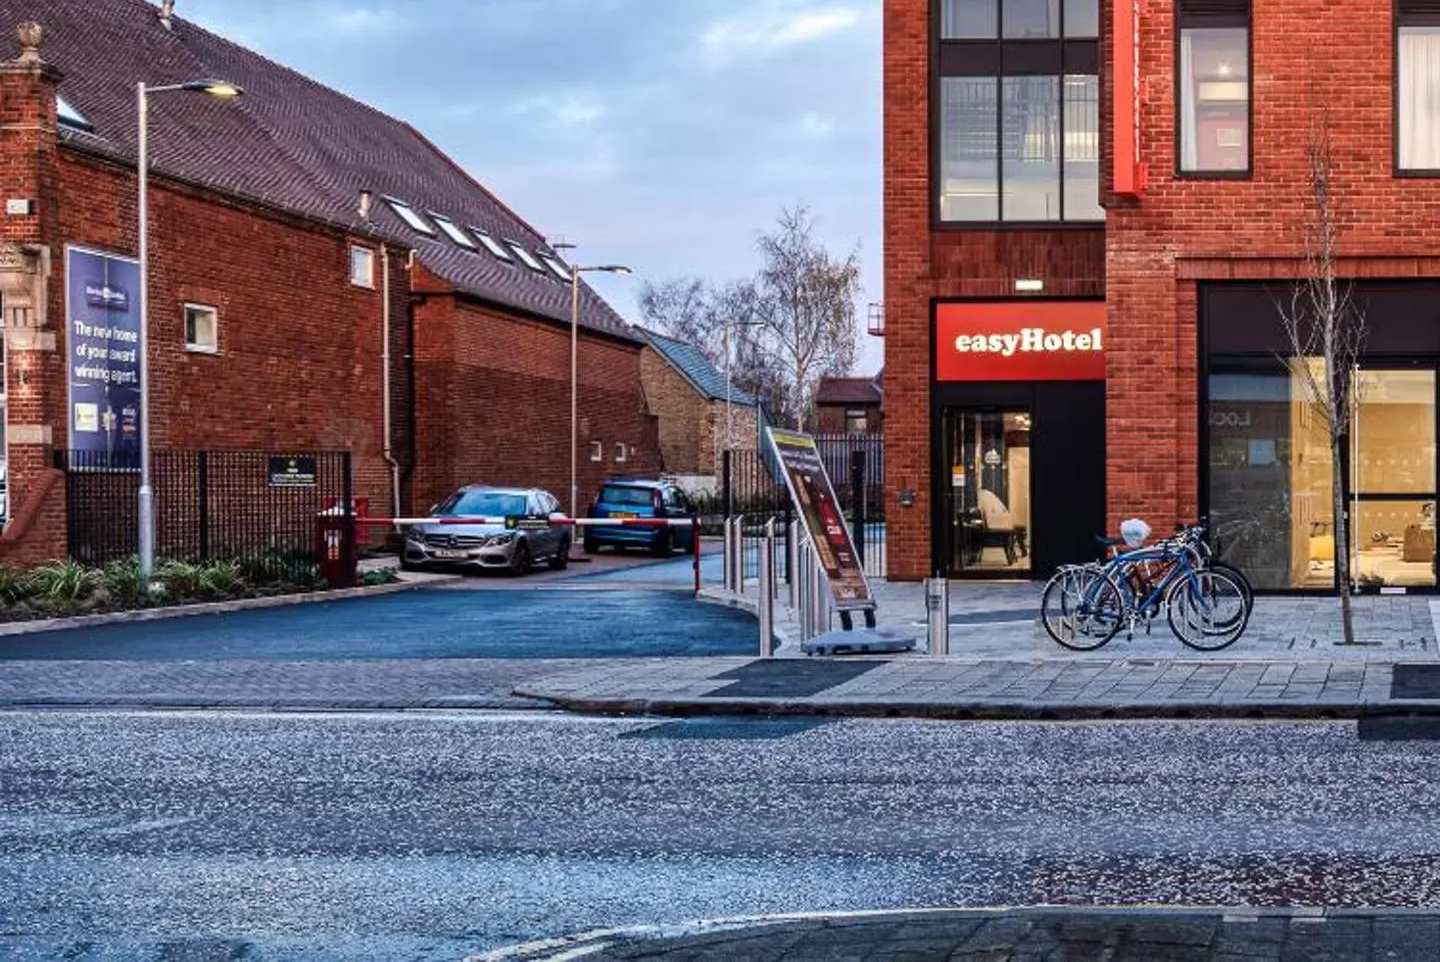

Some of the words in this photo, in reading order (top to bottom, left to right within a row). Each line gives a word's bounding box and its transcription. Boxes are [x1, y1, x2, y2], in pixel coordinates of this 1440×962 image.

[74, 320, 92, 337] The
[93, 326, 112, 340] new
[112, 325, 138, 343] home
[955, 328, 1103, 356] easyHotel
[76, 343, 87, 357] of
[87, 346, 108, 360] your
[109, 349, 136, 363] award
[74, 364, 110, 383] winning
